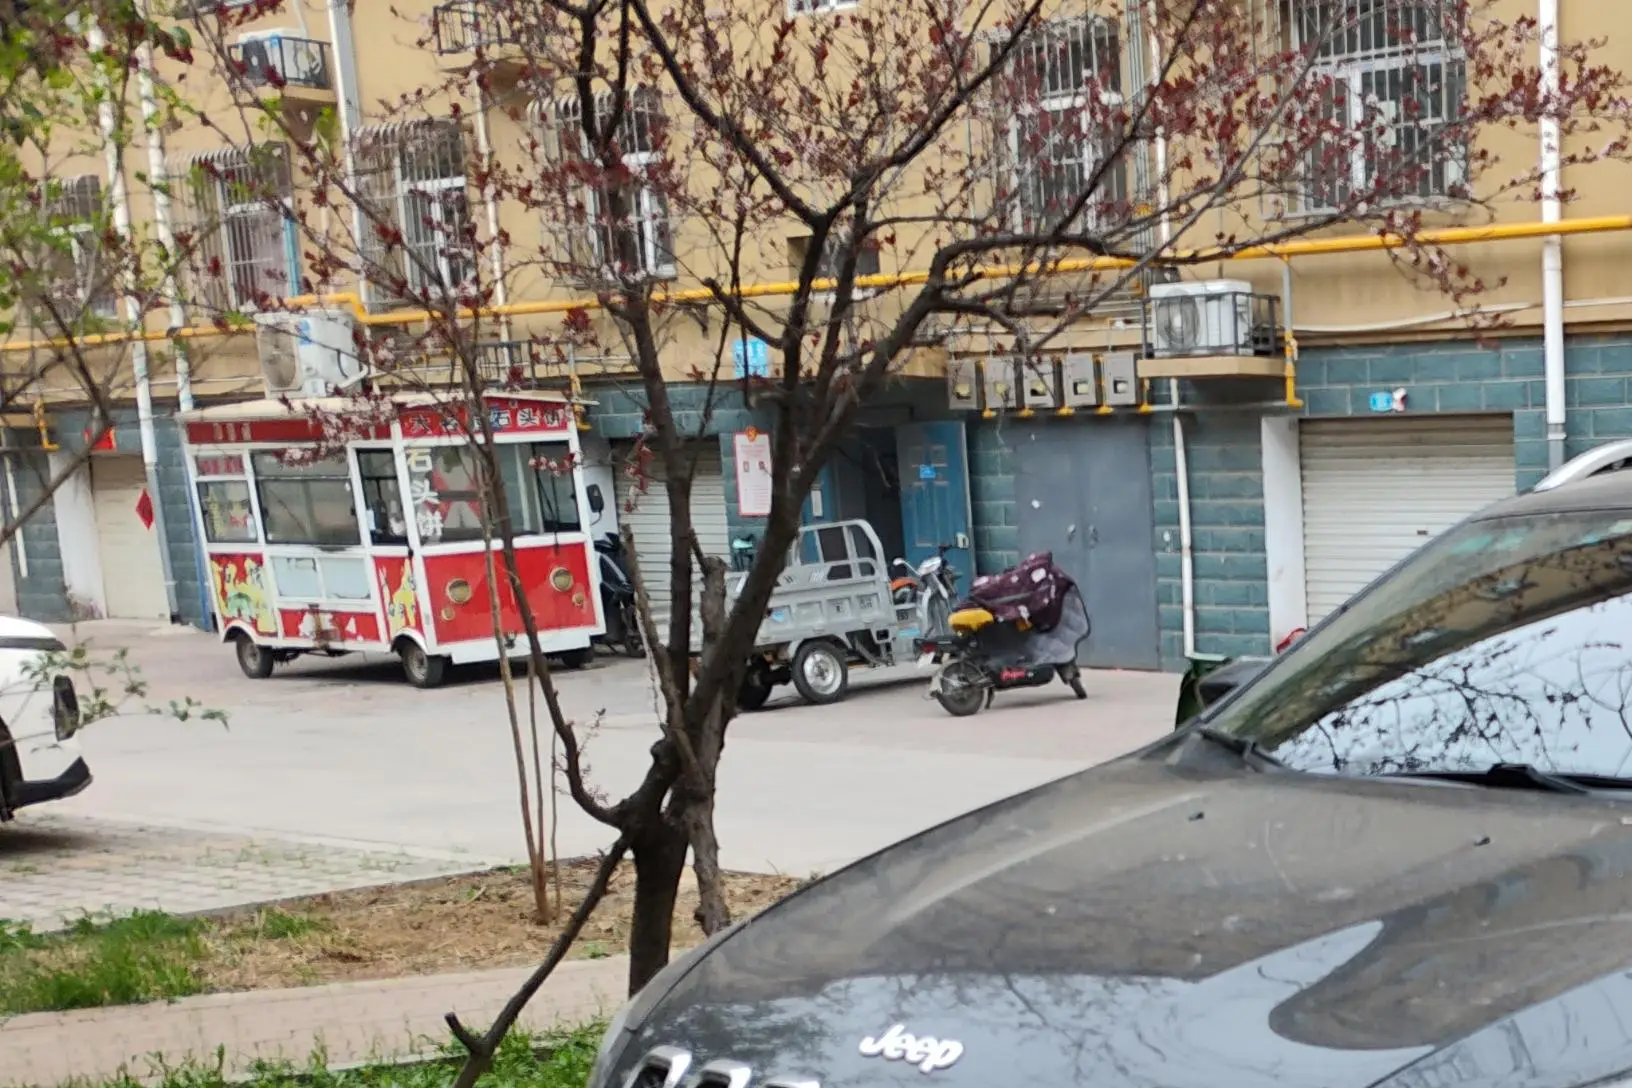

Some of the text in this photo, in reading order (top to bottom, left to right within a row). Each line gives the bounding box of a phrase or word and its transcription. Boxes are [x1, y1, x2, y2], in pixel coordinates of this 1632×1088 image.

[407, 448, 444, 537] 石头饼
[859, 1023, 964, 1074] Jeep
